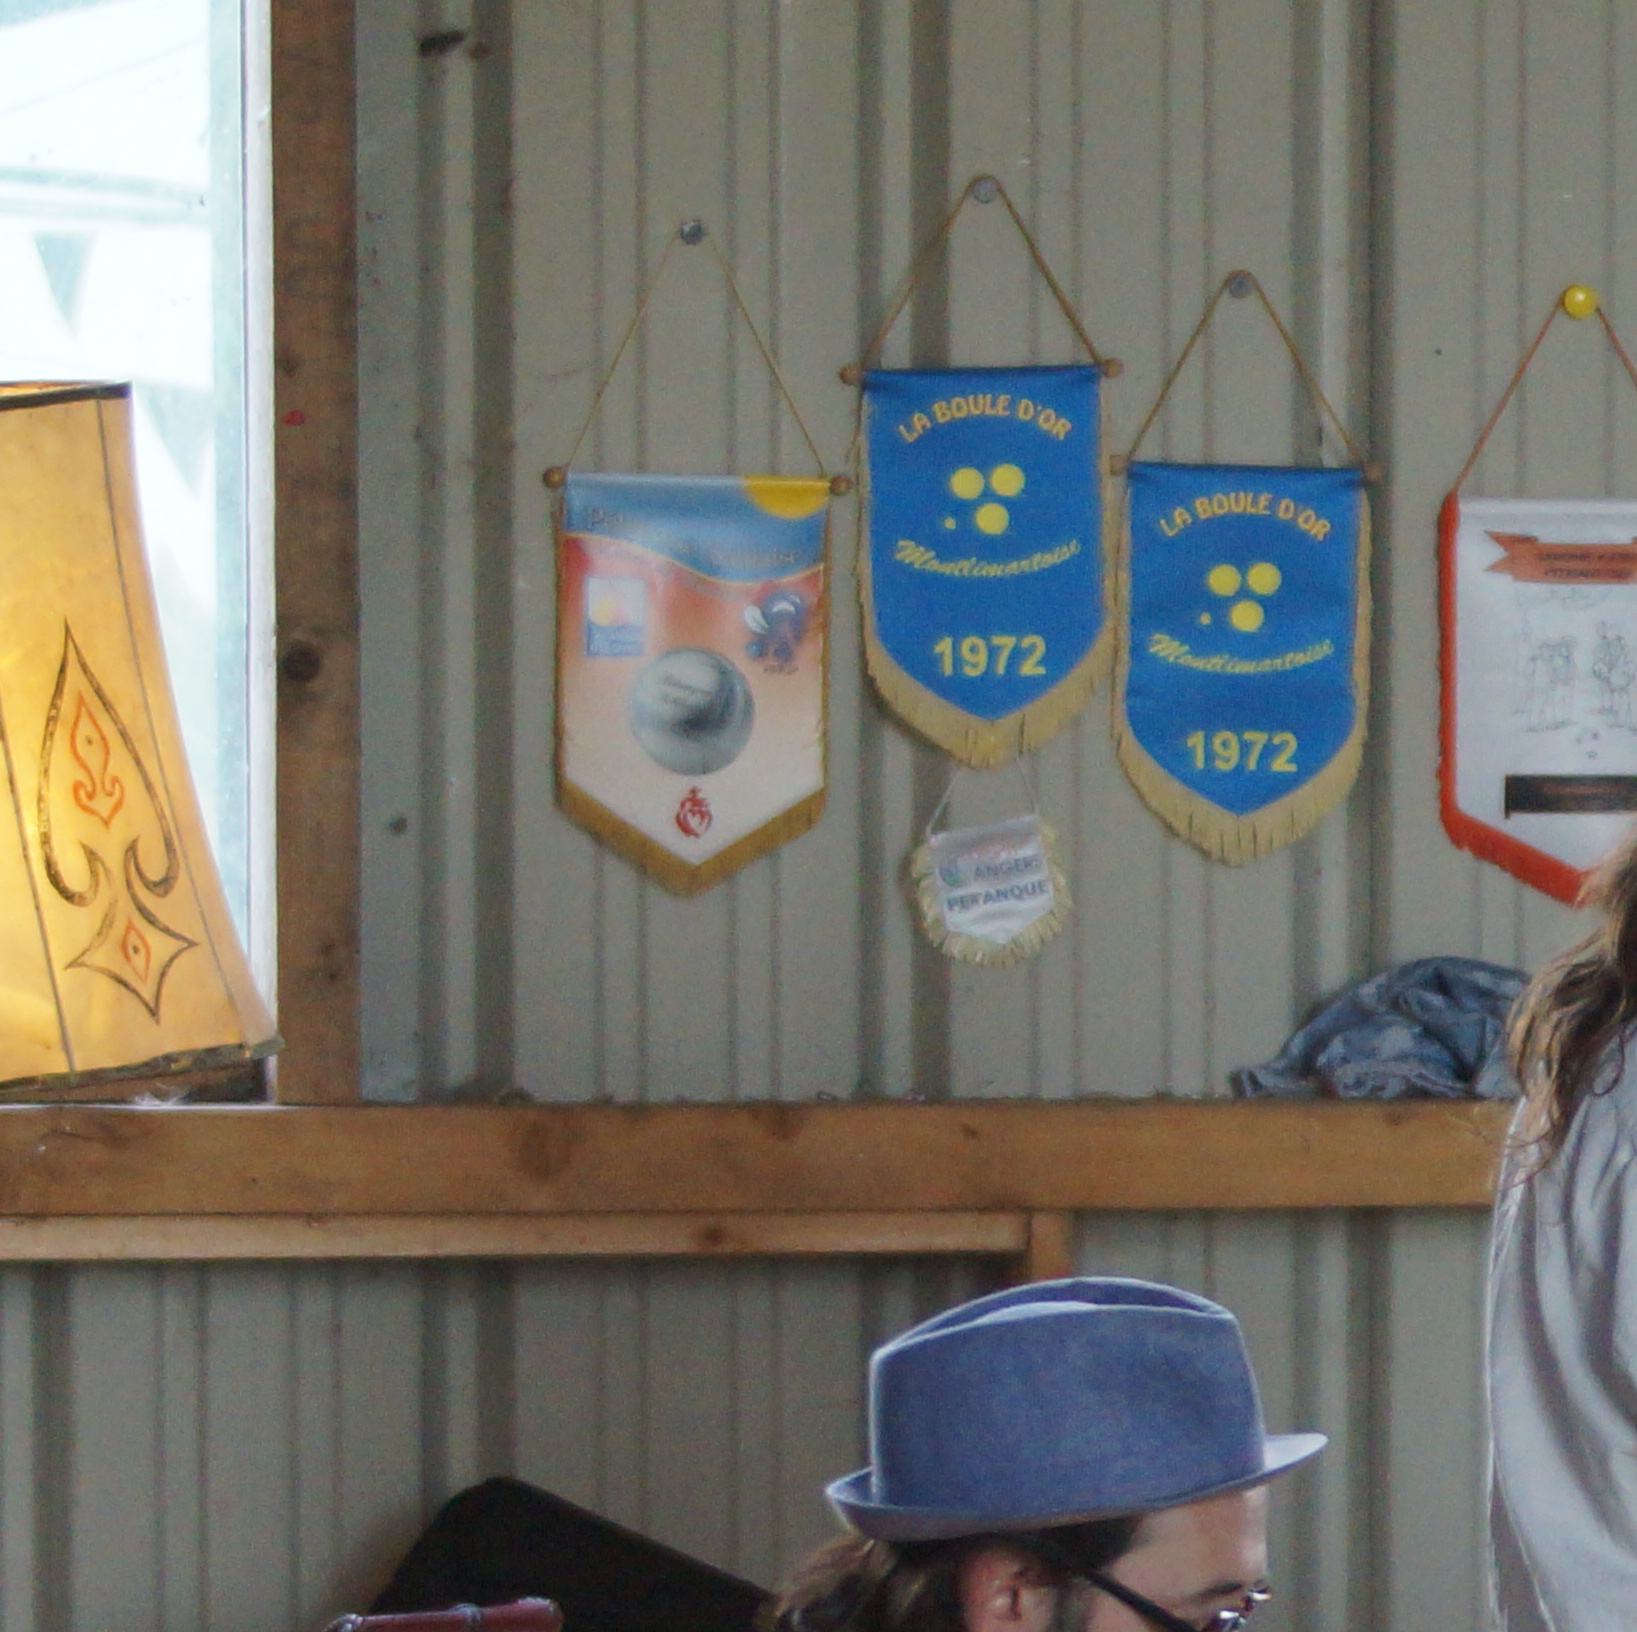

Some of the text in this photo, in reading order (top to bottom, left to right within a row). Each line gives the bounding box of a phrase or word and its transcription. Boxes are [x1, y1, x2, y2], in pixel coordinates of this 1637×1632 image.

[899, 394, 1072, 442] LA BOULE D'OR
[1159, 506, 1192, 537] LA
[1194, 491, 1273, 520] BOULE
[934, 635, 1047, 676] 1972
[1187, 731, 1299, 772] 1972
